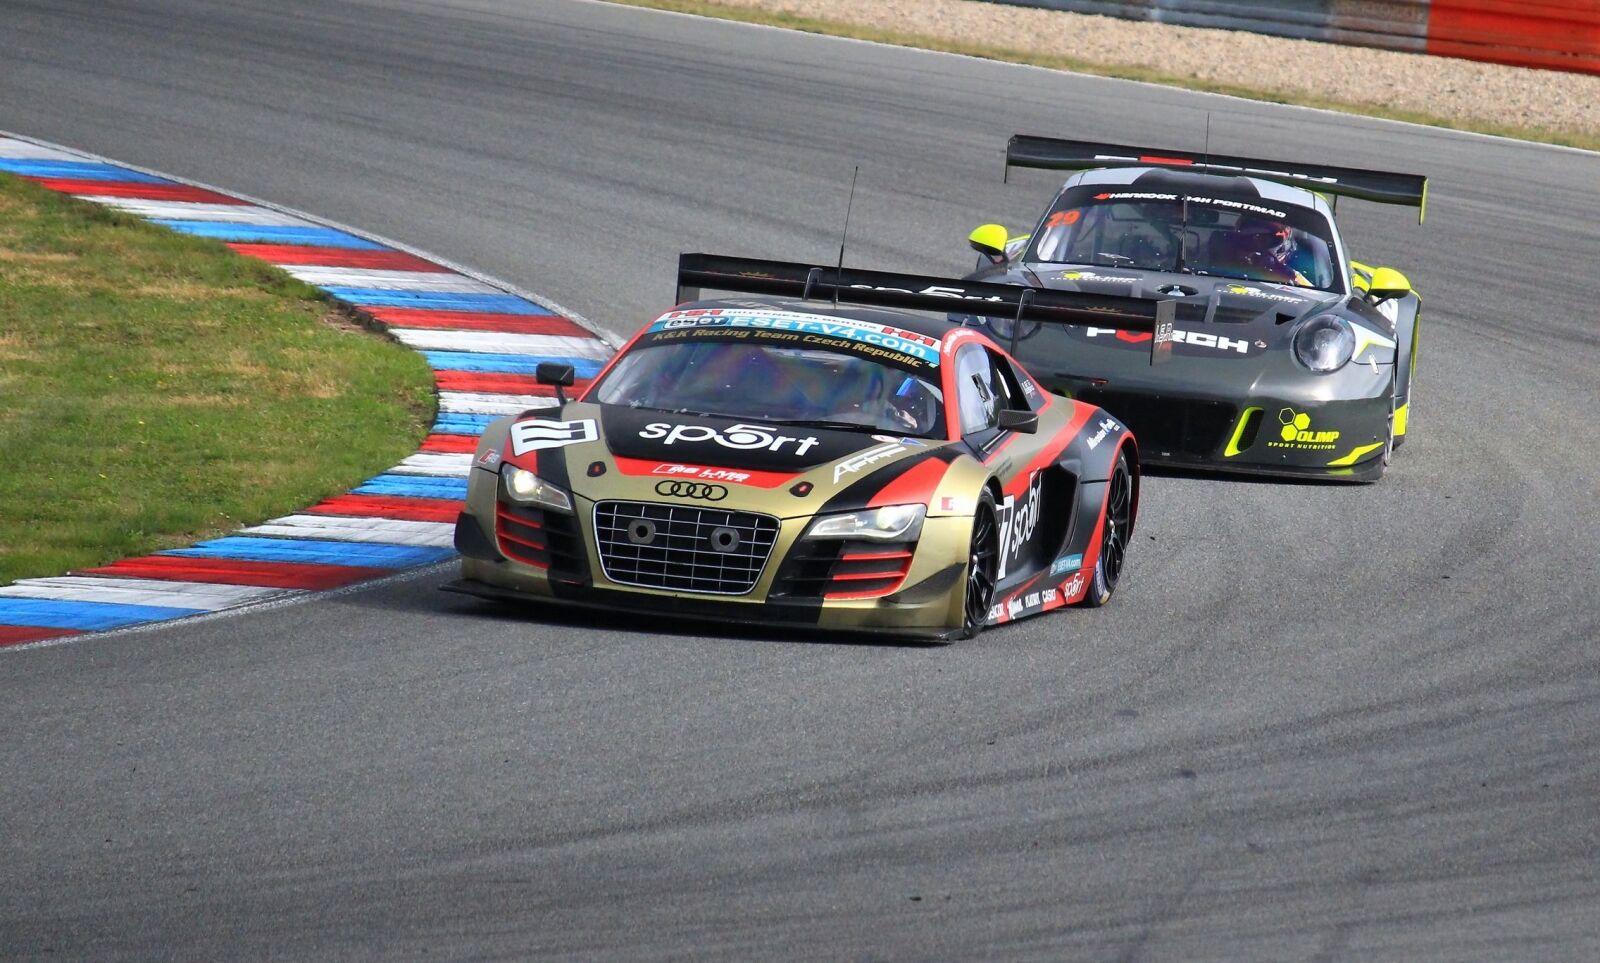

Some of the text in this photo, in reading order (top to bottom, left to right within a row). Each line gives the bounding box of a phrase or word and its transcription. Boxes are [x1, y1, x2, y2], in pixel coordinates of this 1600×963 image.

[1045, 209, 1081, 229] 29
[653, 328, 923, 368] K&K Racing Team Czech Republic
[1296, 431, 1340, 443] OLIMP
